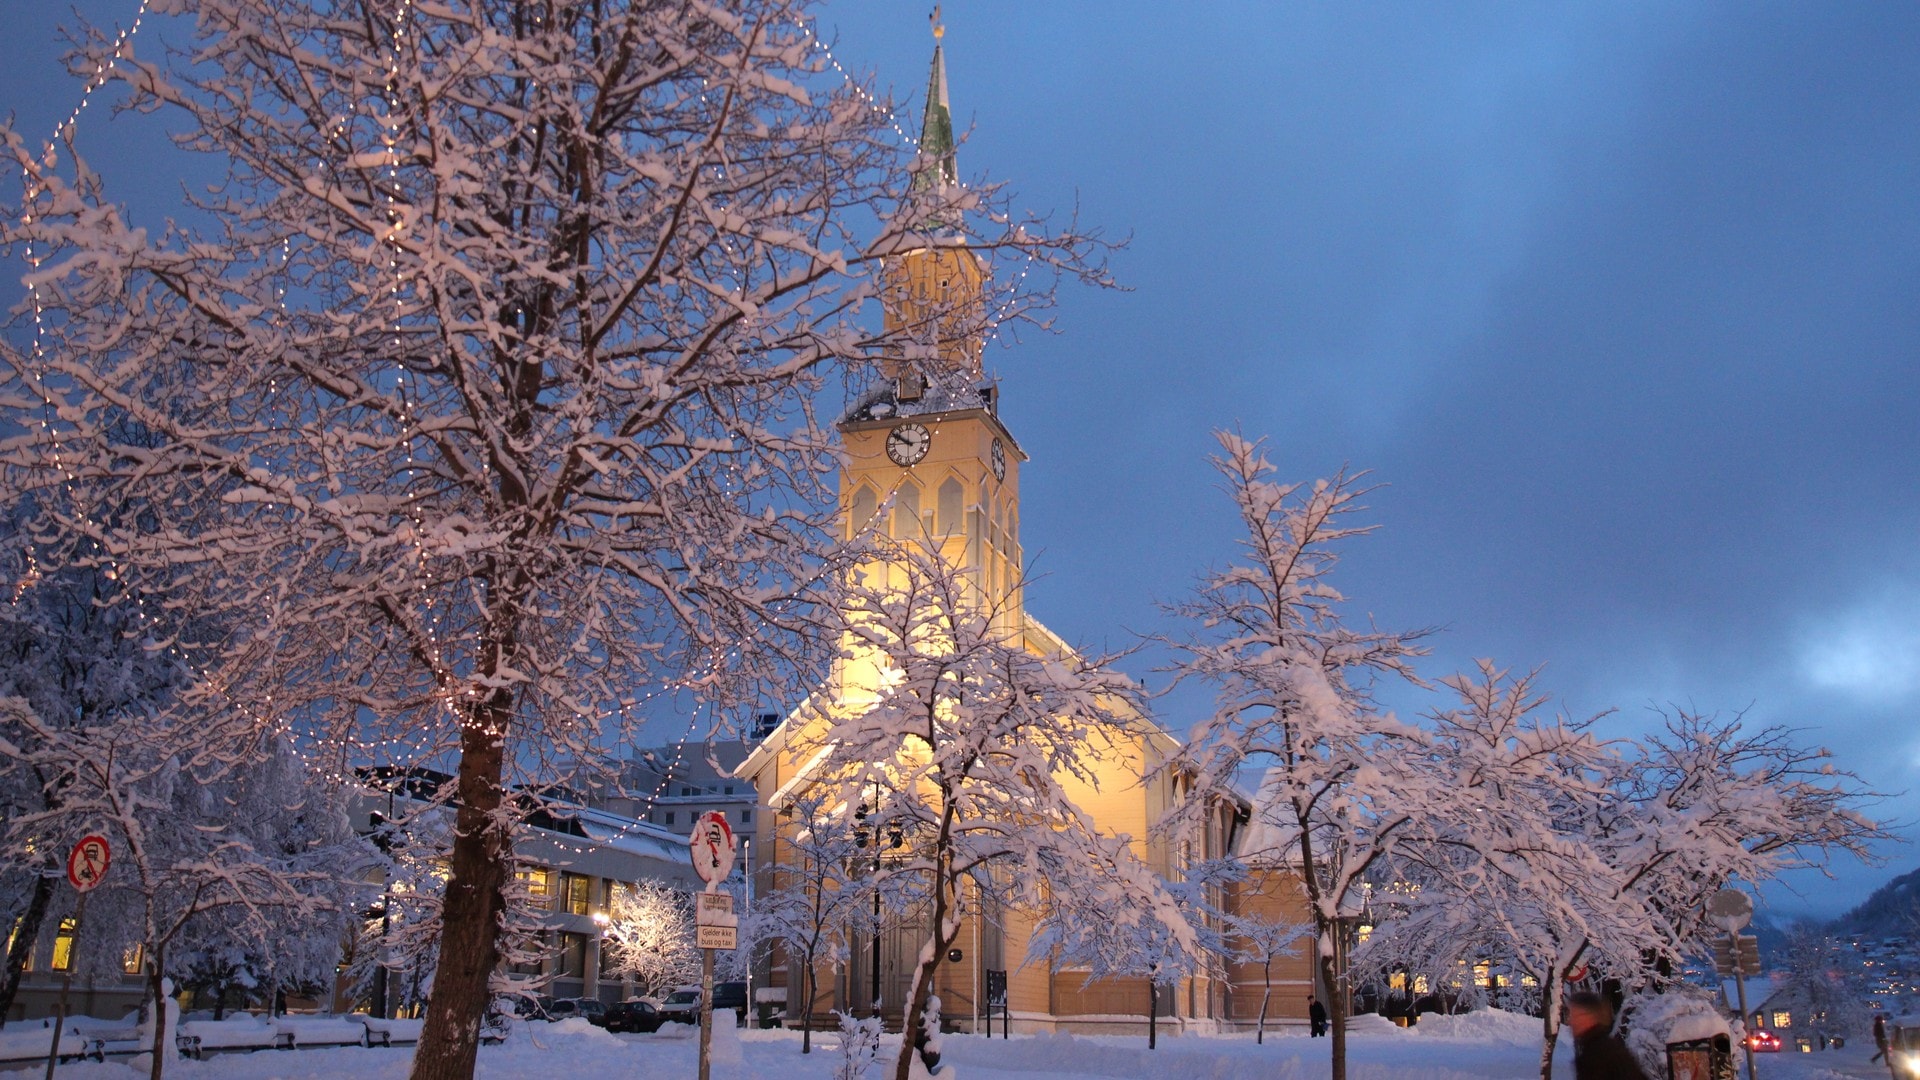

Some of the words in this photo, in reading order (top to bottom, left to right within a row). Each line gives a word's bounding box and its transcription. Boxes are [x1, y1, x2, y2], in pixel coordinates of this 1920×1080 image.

[702, 928, 720, 938] Gjelder
[721, 929, 733, 937] ikke
[714, 939, 721, 947] og
